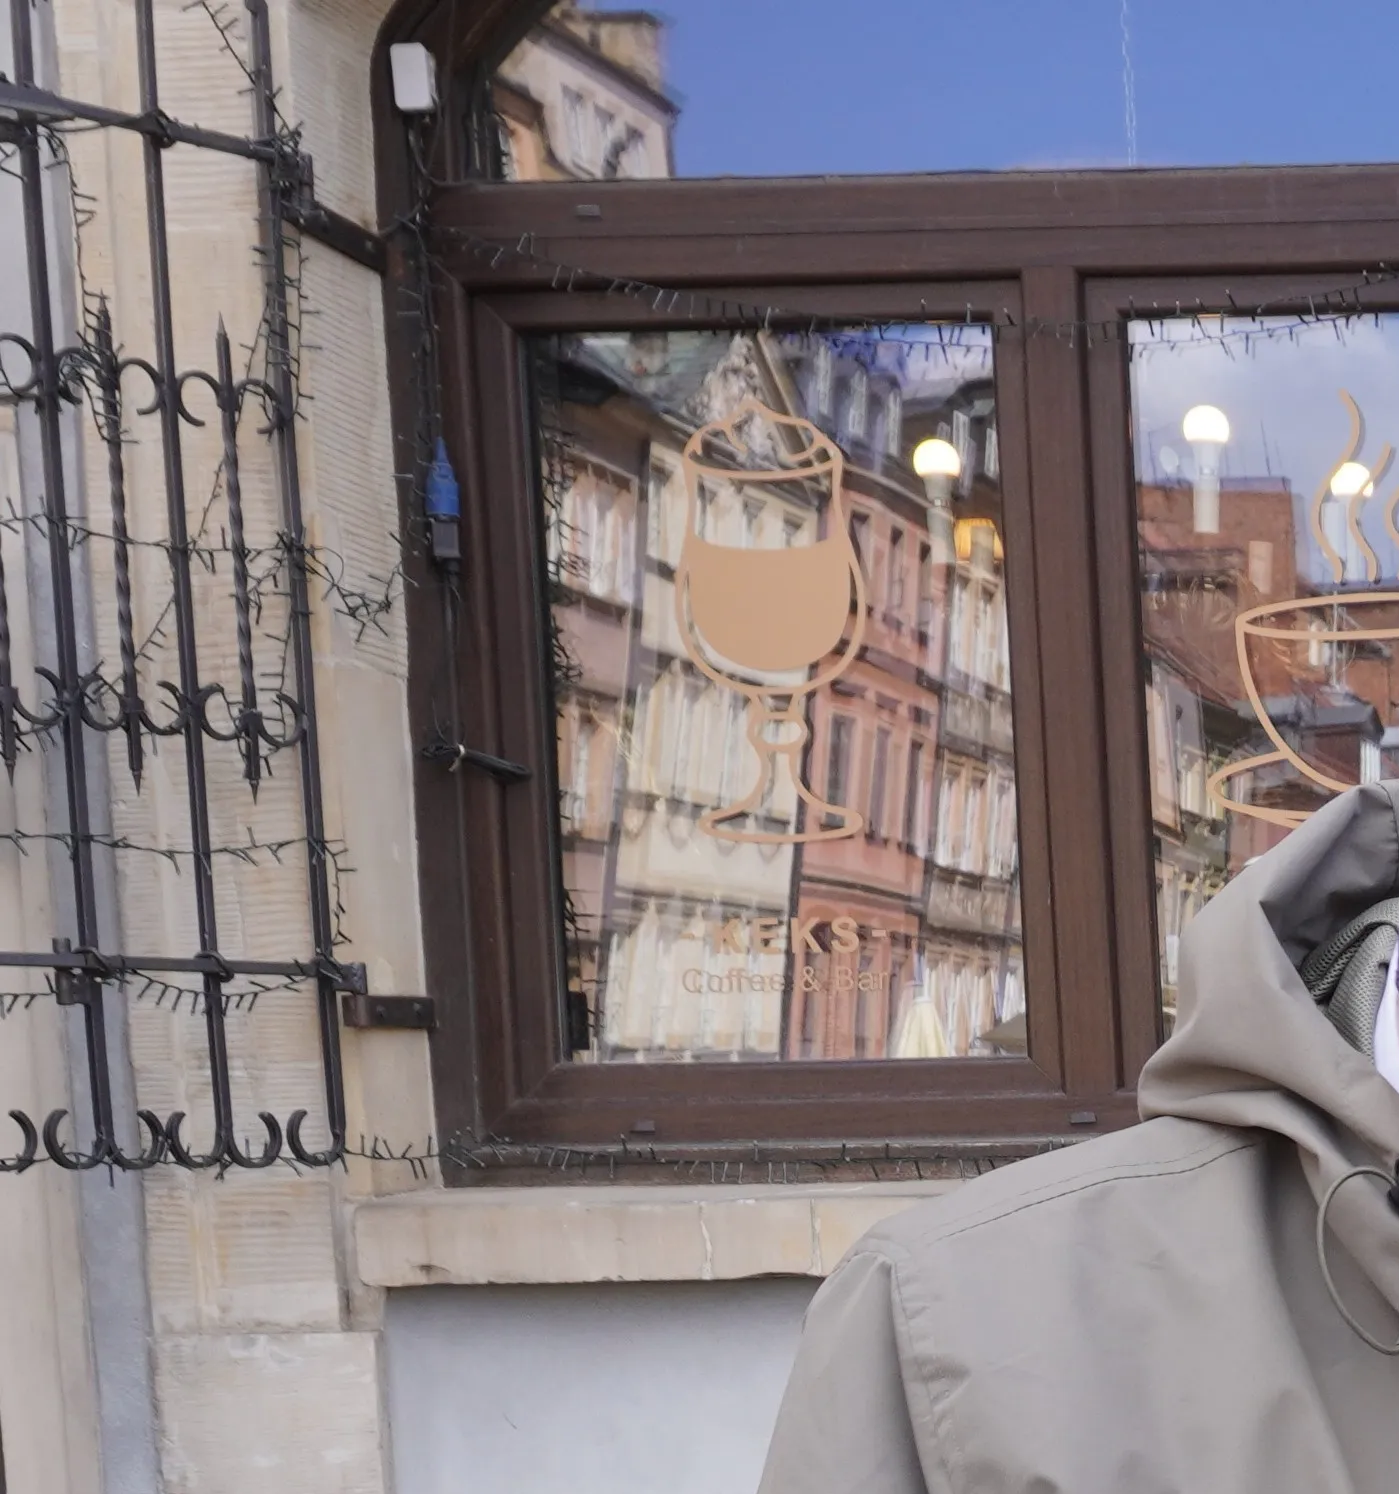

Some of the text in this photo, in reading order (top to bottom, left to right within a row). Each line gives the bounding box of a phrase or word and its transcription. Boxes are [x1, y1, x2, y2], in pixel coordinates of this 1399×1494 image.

[682, 965, 891, 994] Coffee & Bar
